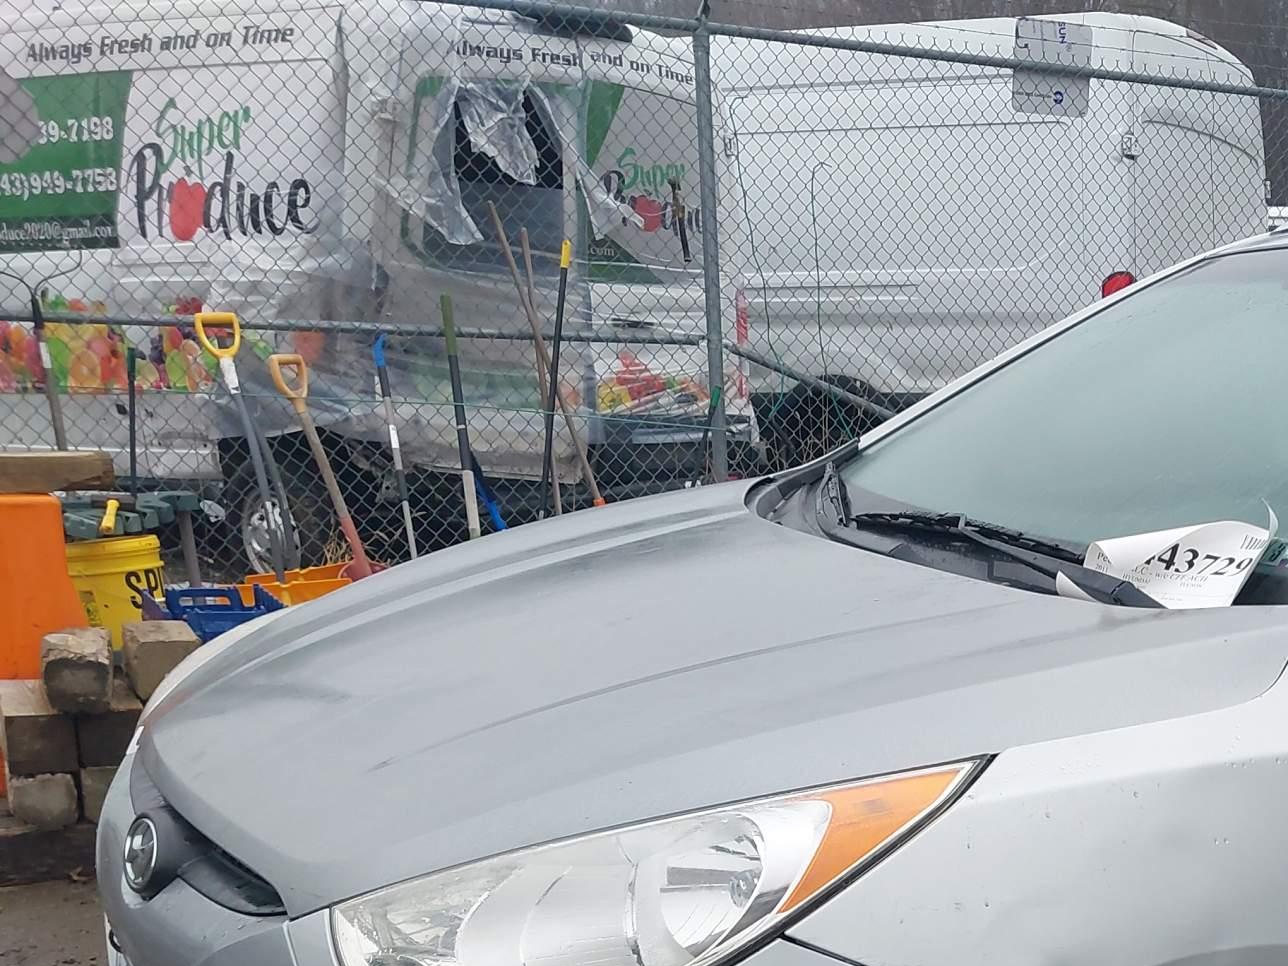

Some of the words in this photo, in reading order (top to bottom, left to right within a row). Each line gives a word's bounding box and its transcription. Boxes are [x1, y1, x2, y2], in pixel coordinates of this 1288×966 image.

[26, 40, 92, 64] Always
[100, 33, 152, 56] Fresh
[160, 30, 198, 50] and
[205, 31, 231, 47] on
[243, 25, 294, 45] Time
[531, 46, 581, 67] Fresh
[590, 52, 623, 68] and
[630, 60, 651, 74] on
[657, 64, 694, 86] Time
[155, 97, 251, 180] Super
[615, 147, 686, 197] Super
[1144, 543, 1253, 577] 43729
